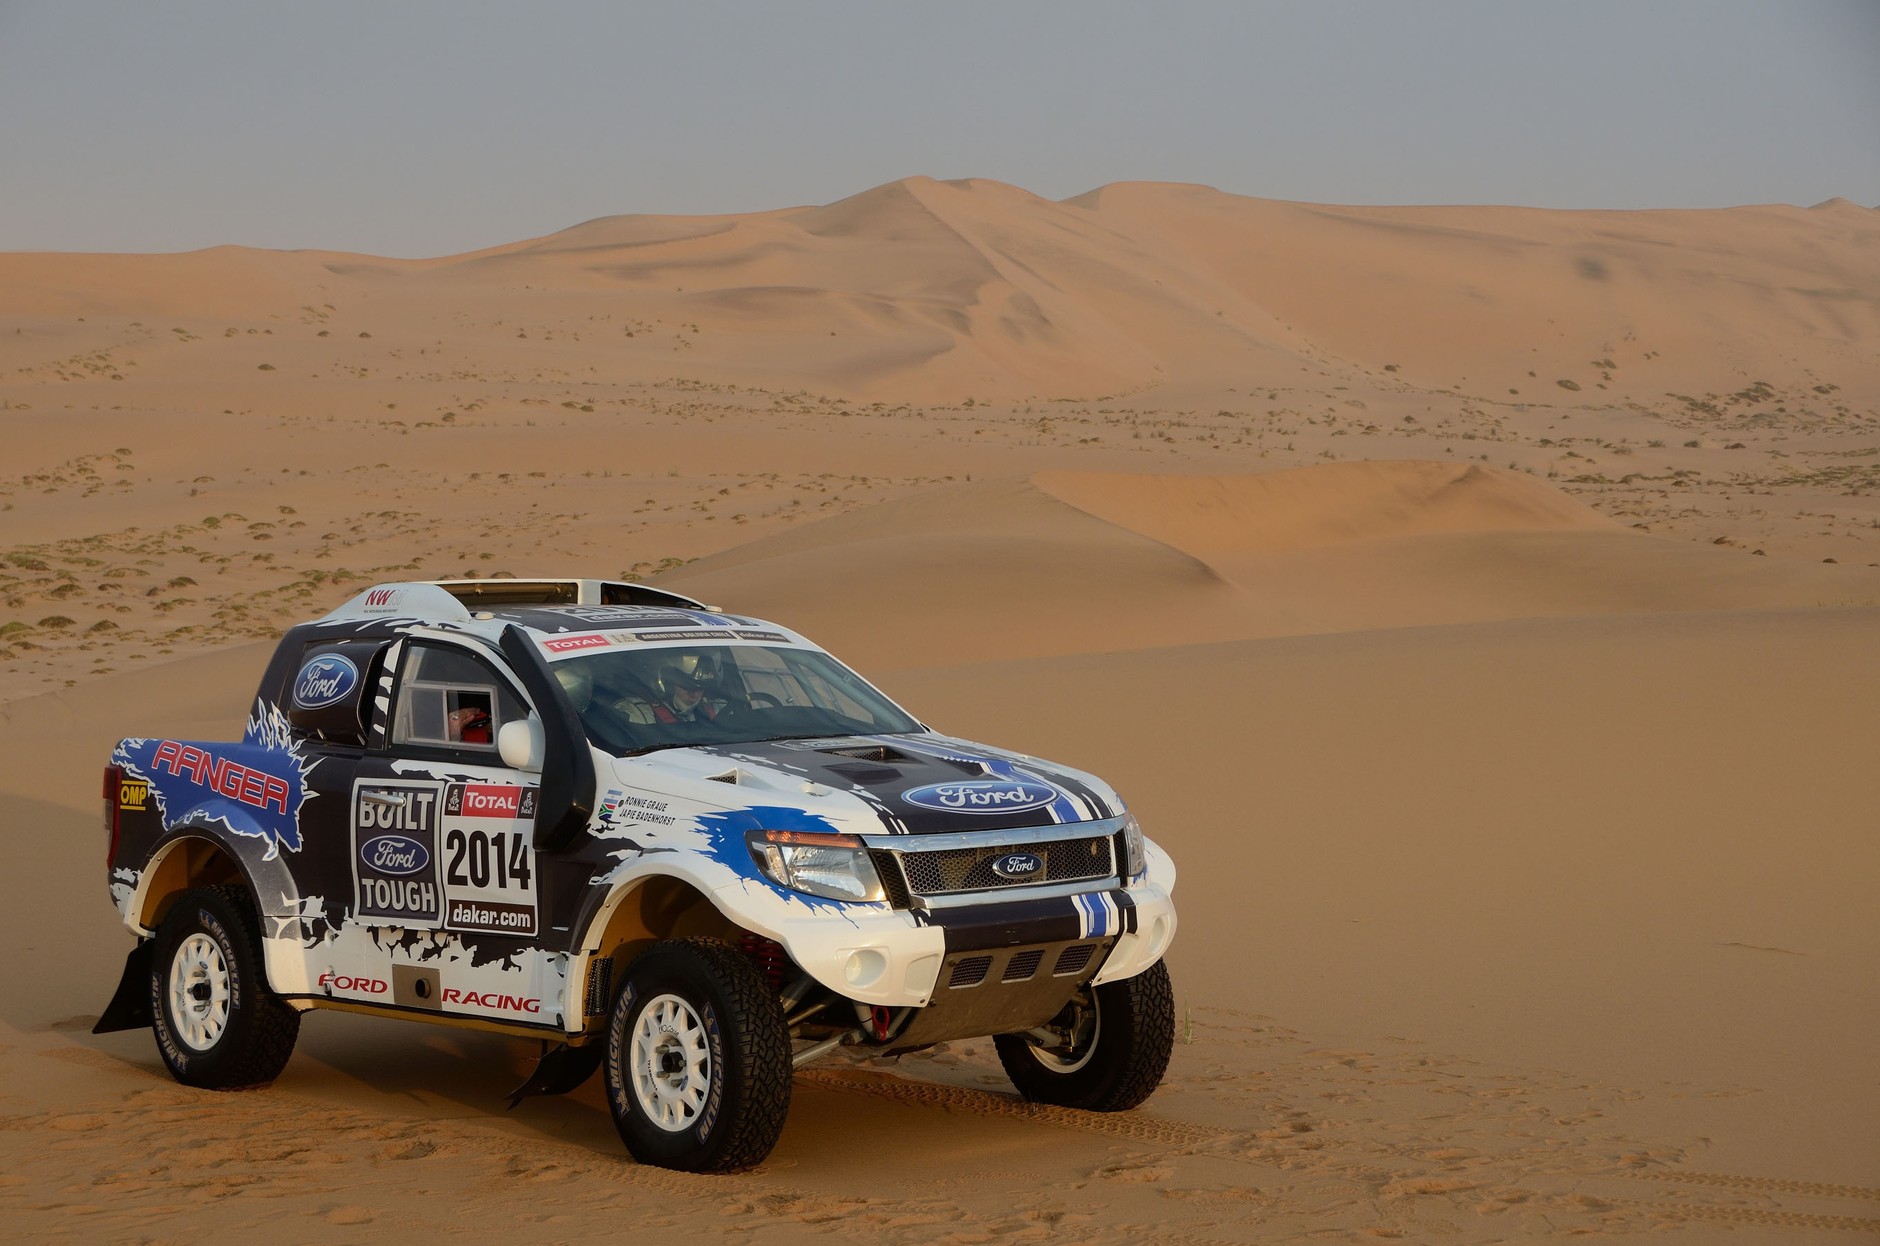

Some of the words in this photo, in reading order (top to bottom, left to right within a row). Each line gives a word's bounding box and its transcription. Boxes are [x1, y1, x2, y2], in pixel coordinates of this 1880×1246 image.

[547, 638, 605, 649] TOTAL
[300, 662, 344, 698] Ford
[152, 740, 289, 815] RANGER
[121, 785, 147, 805] OMP
[467, 792, 517, 810] TOTAL
[625, 796, 648, 809] RONNIE
[935, 784, 1035, 807] Ford
[359, 790, 435, 831] BUILT
[619, 808, 637, 820] JAPIE
[635, 812, 676, 826] BADENHORST
[374, 840, 416, 868] Ford
[446, 829, 531, 890] 2014
[1007, 856, 1035, 873] Ford
[362, 878, 436, 913] TOUGH
[453, 903, 531, 928] dakar.com
[318, 974, 388, 994] FORD
[442, 988, 541, 1014] RACING
[609, 985, 634, 1090] MICHELIN
[700, 1033, 723, 1140] MICHELIN
